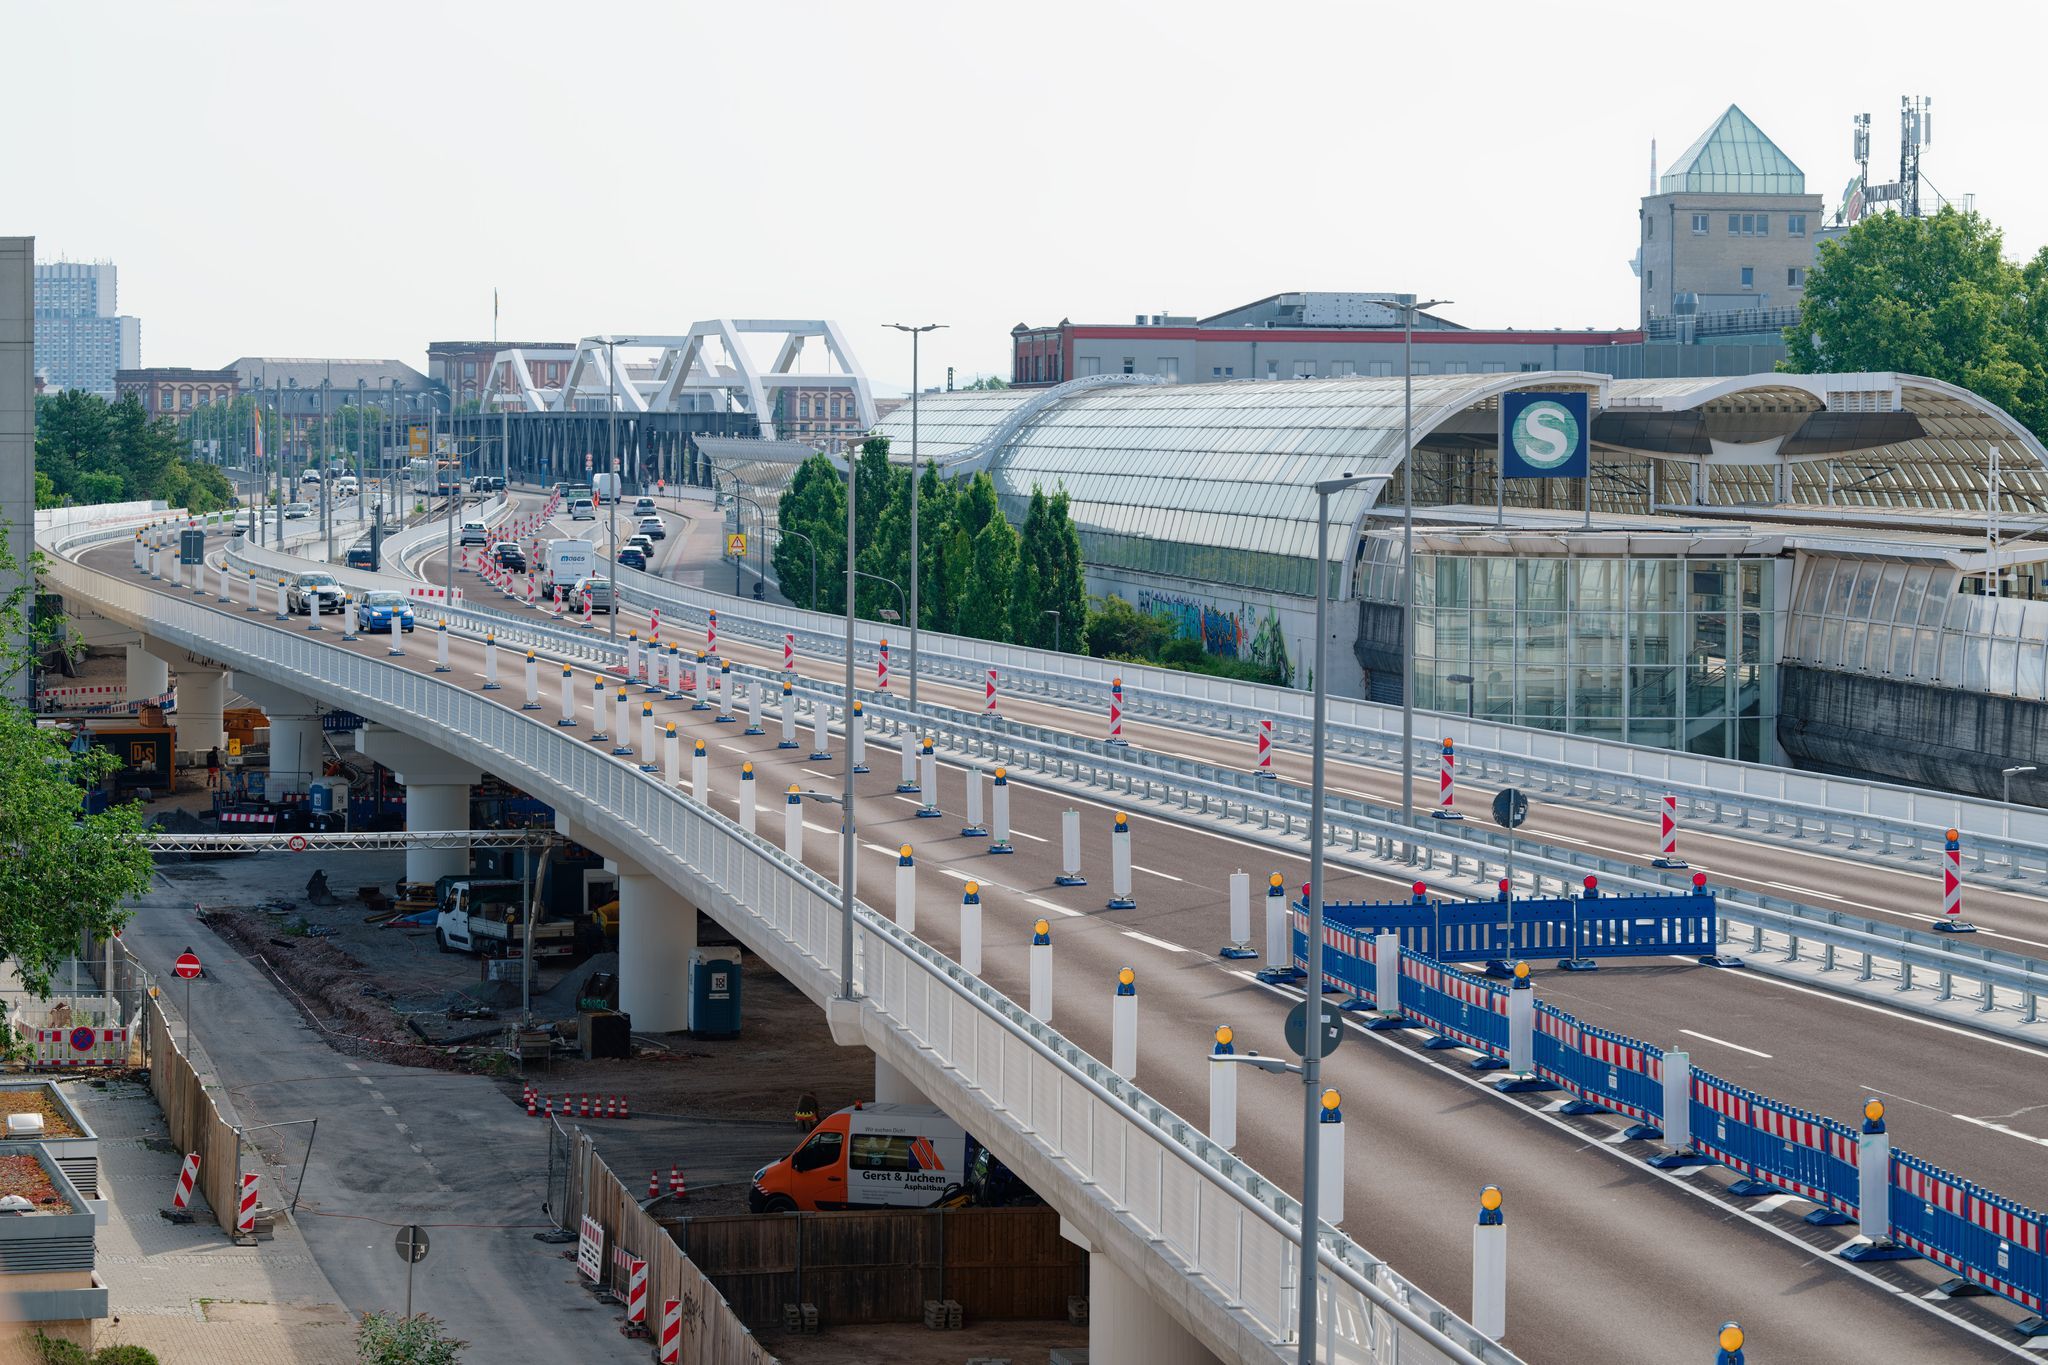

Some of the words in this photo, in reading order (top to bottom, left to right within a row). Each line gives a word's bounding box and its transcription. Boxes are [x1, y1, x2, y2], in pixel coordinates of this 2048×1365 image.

[1525, 407, 1568, 462] S
[862, 1171, 891, 1181] Gerst
[894, 1172, 902, 1181] &
[905, 1173, 946, 1183] Juchem
[904, 1183, 946, 1192] Asphaltbau
